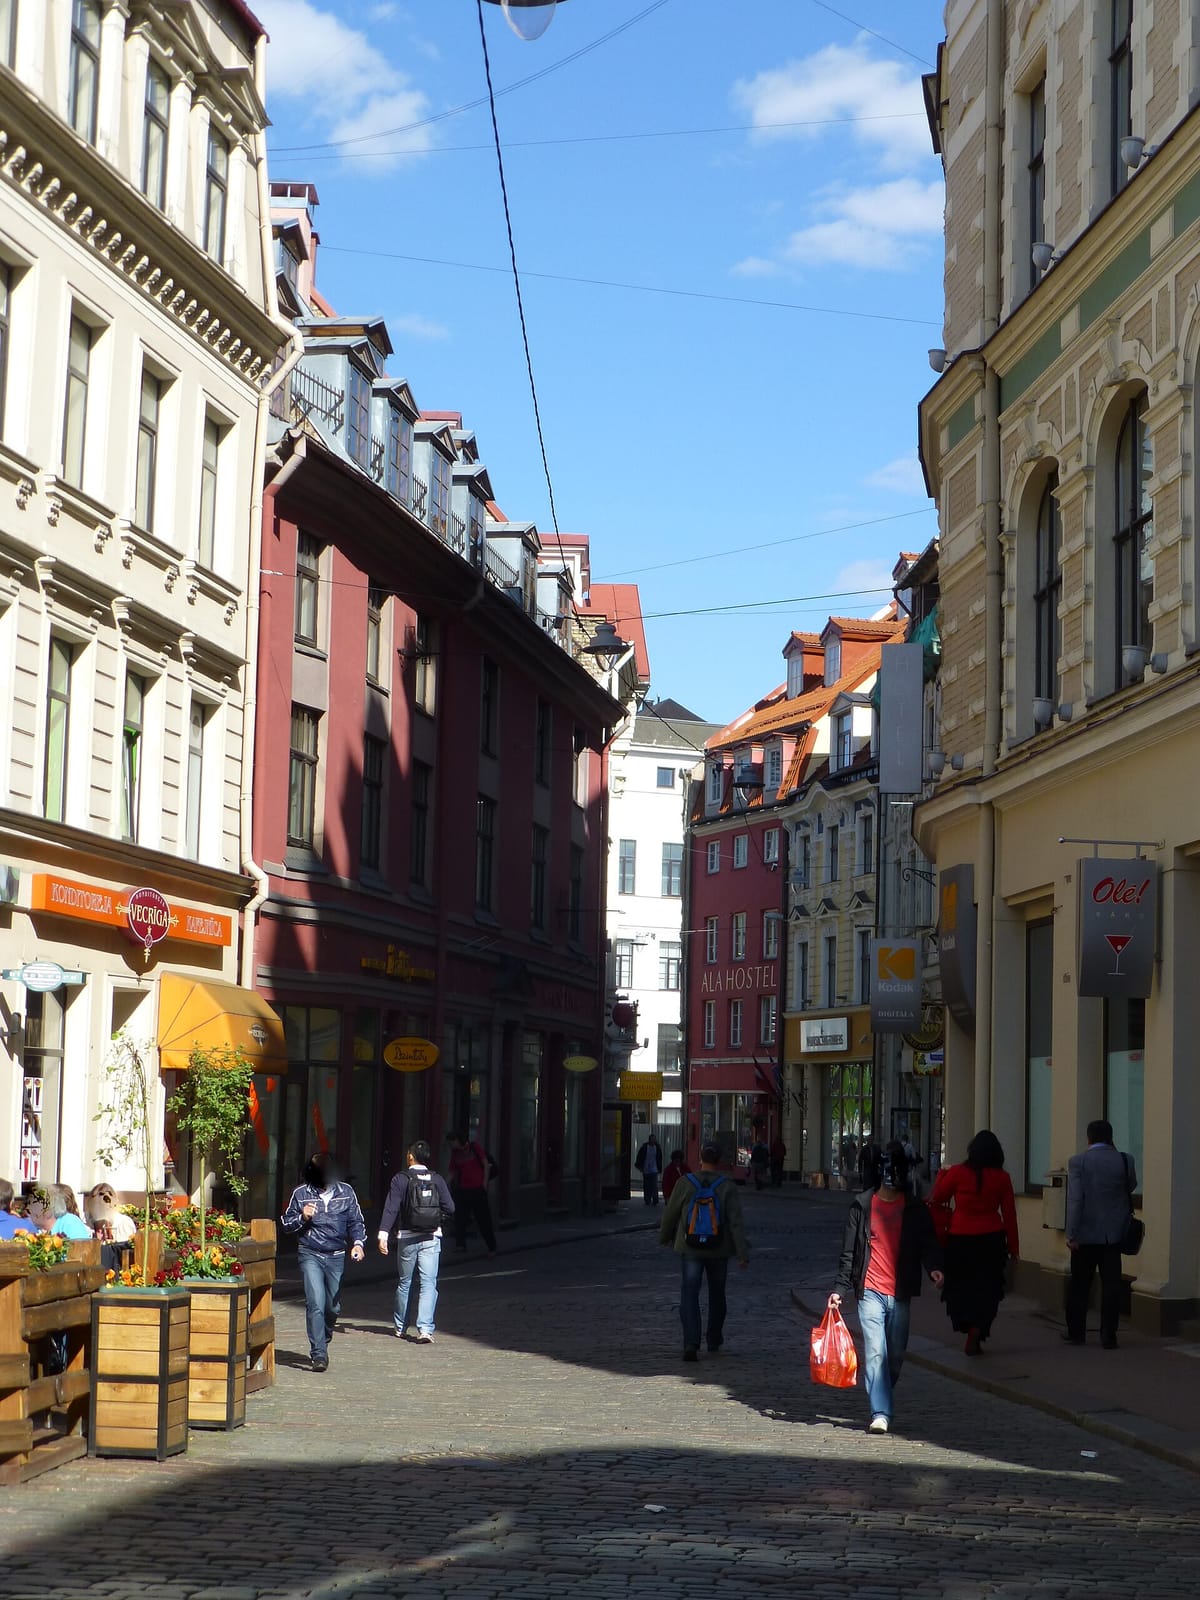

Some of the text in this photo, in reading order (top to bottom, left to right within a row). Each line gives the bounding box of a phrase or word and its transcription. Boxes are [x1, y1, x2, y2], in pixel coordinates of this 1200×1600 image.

[51, 882, 113, 914] KONDITOREJA
[1092, 876, 1151, 904] Olé!
[130, 903, 169, 928] VECRĪGA
[701, 964, 777, 993] ALA HOSTEL
[877, 982, 915, 993] Kodak
